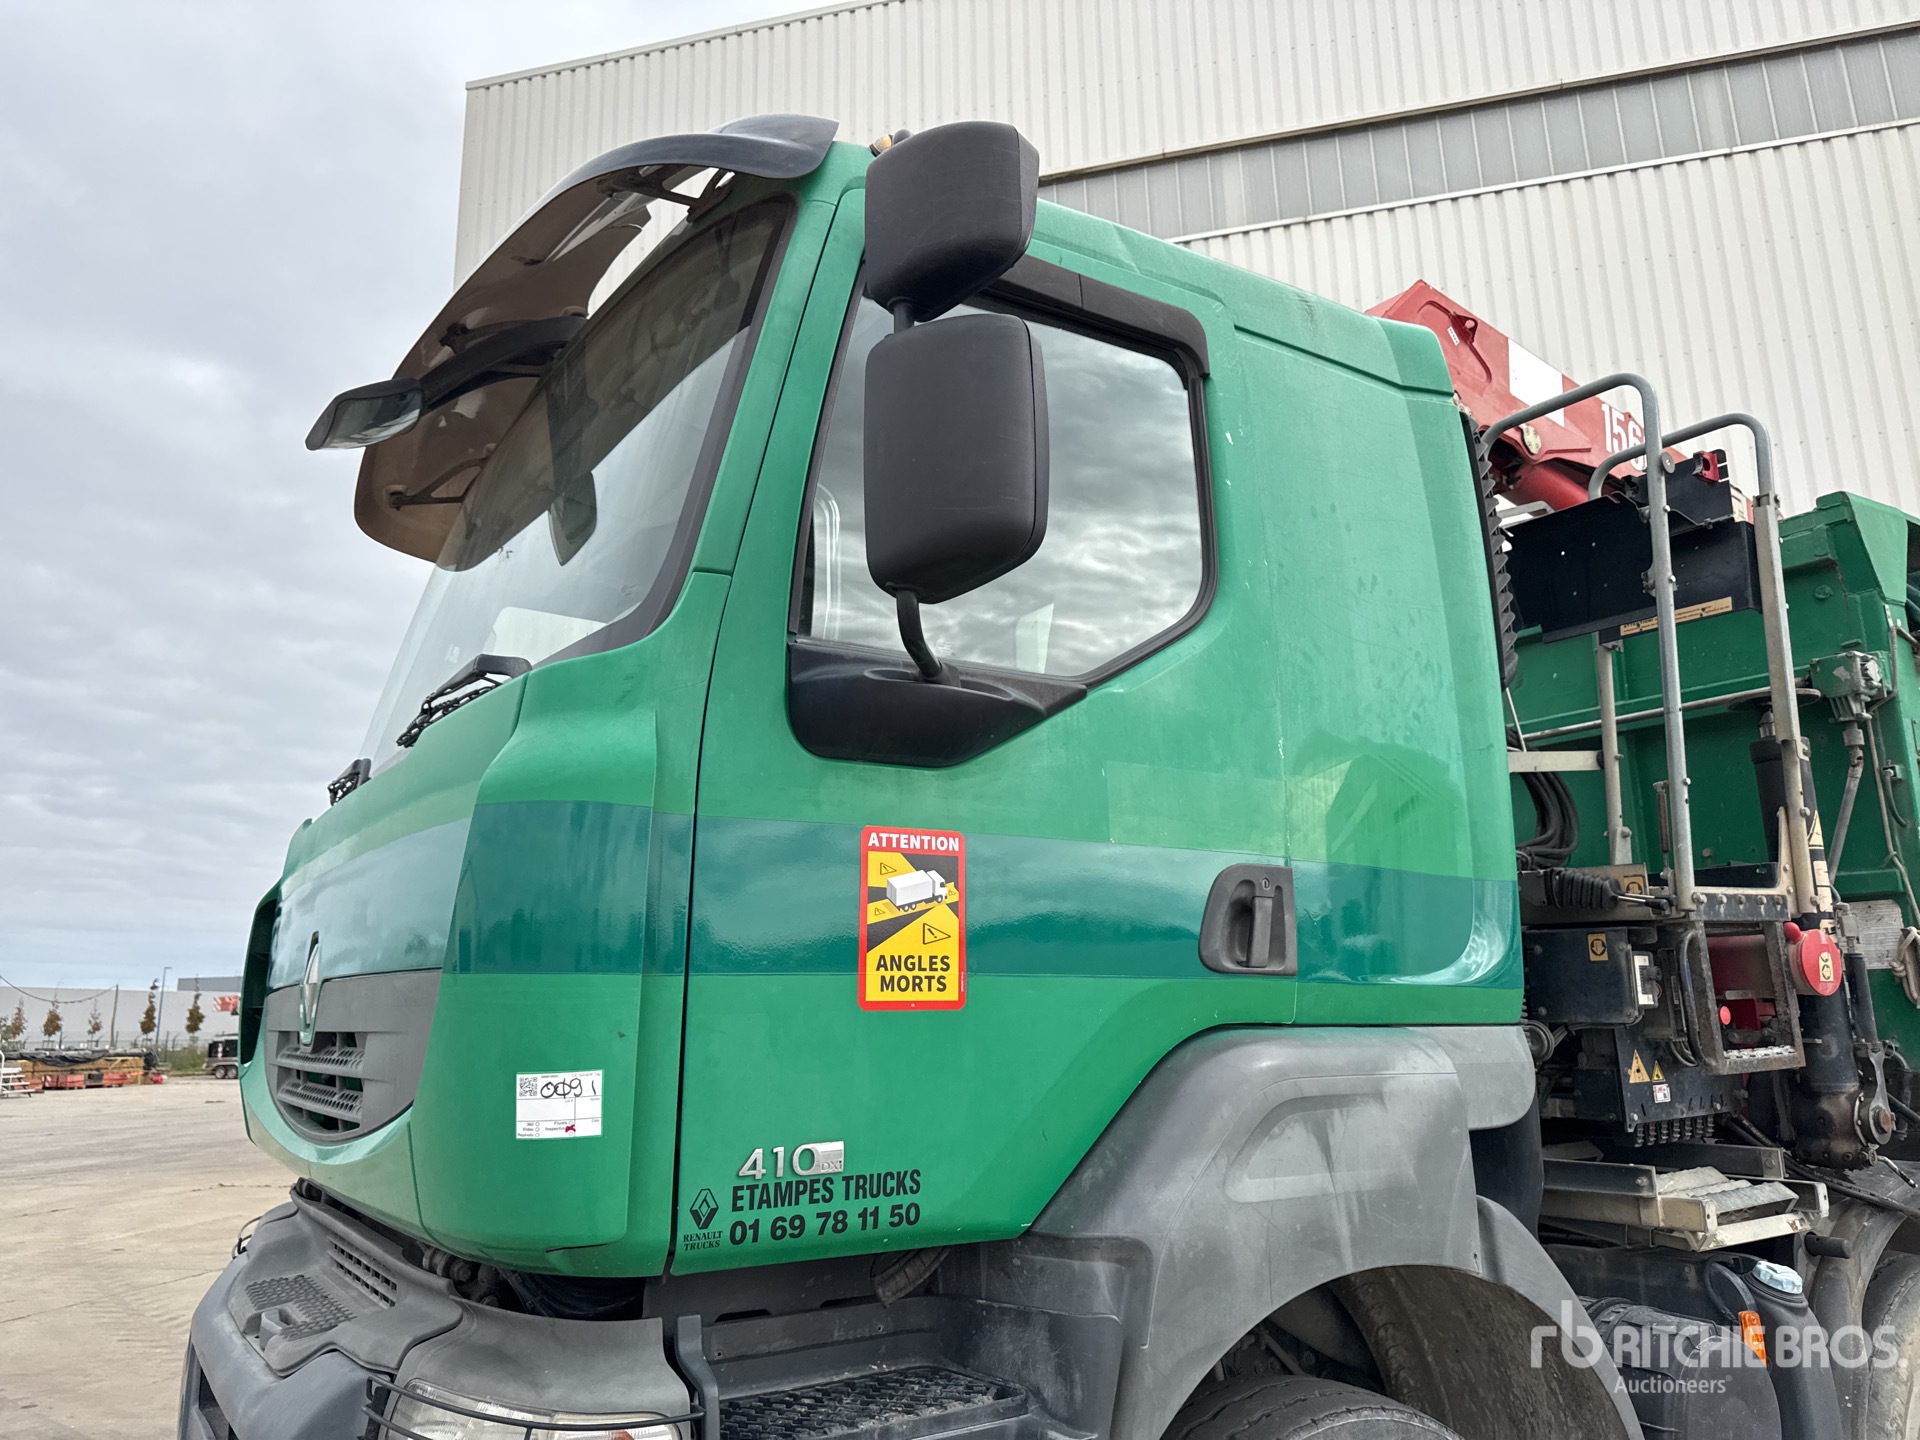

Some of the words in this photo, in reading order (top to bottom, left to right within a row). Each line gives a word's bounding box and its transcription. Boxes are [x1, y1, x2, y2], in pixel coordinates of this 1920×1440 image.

[1601, 403, 1648, 471] 156
[868, 832, 959, 851] ATTENTION
[876, 954, 950, 972] ANGLES
[880, 975, 947, 992] MORTS
[738, 1143, 820, 1180] 410
[821, 1160, 843, 1172] DXi
[731, 1176, 834, 1212] ETAMPES
[842, 1169, 921, 1201] TRUCKS
[729, 1219, 760, 1245] 01
[770, 1215, 806, 1241] 69
[816, 1209, 848, 1236] 78
[858, 1206, 880, 1231] 11
[889, 1202, 921, 1228] 50
[683, 1230, 723, 1242] RENAULT
[684, 1241, 721, 1251] TRUCKS
